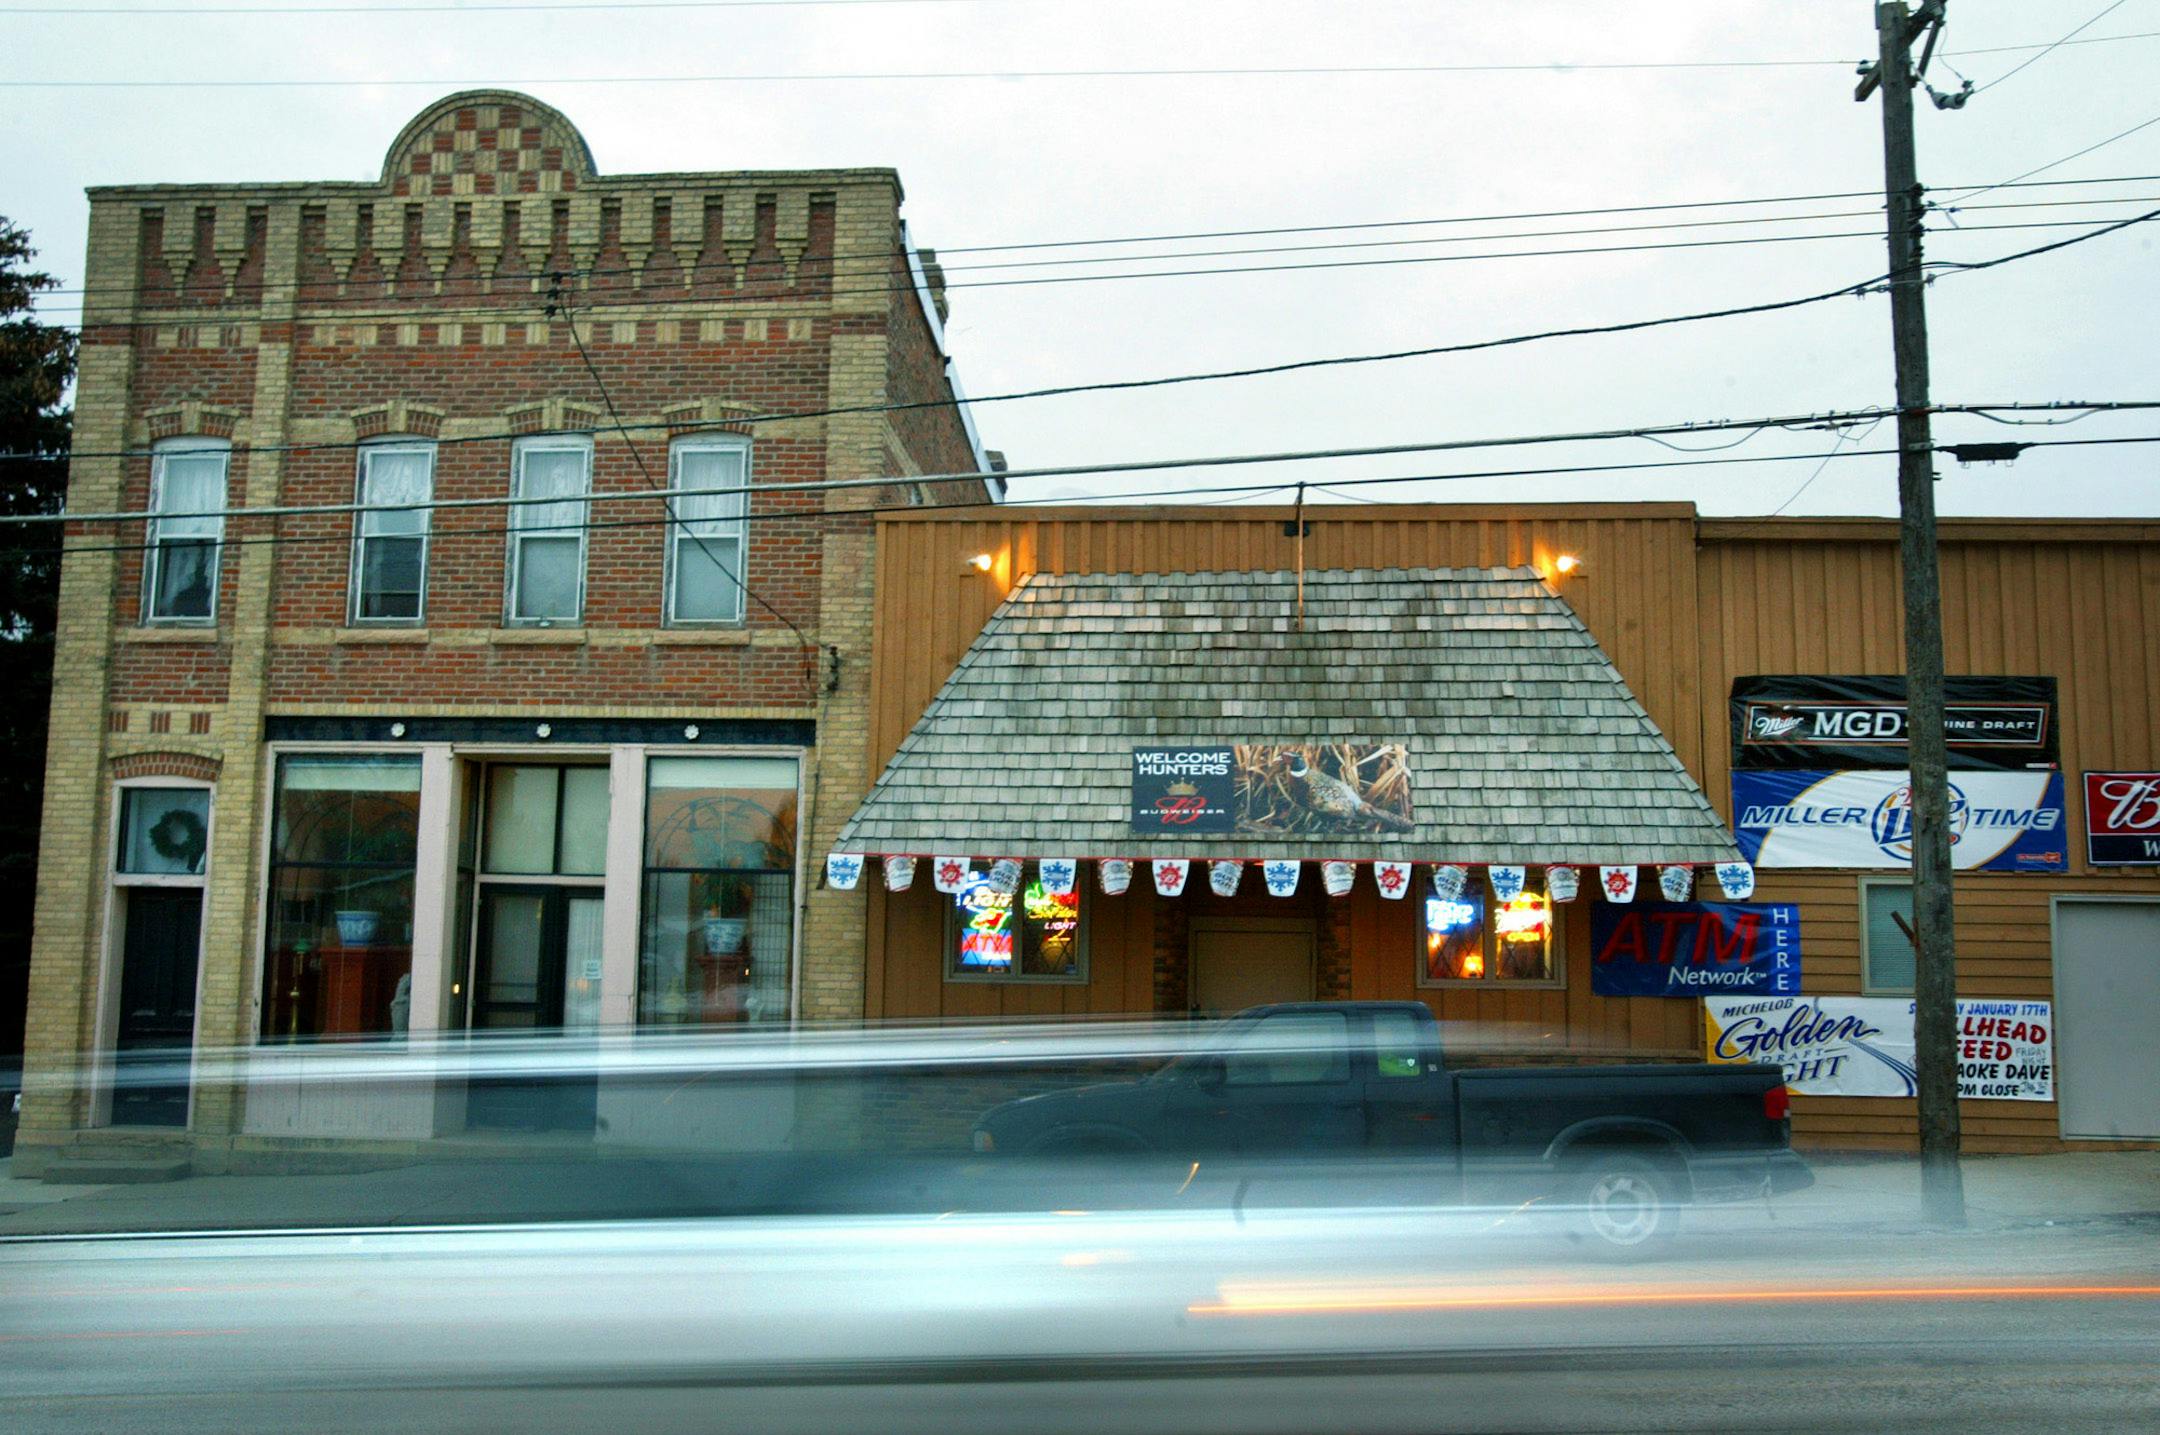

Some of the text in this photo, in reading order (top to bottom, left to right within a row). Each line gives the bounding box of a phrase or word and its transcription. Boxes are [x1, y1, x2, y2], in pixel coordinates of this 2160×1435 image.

[1755, 711, 1901, 736] Miller MGD
[1983, 720, 2036, 730] DRAFT
[1135, 752, 1231, 764] WELCOME
[1139, 763, 1229, 775] HUNTERS
[1741, 805, 1868, 829] MILLER
[1972, 807, 2060, 831] TIME
[1597, 911, 1761, 964] ATM
[1772, 908, 1790, 991] HERE
[1722, 999, 1795, 1018] MICHELOB
[1968, 1003, 2018, 1016] JANUARY
[2021, 1004, 2048, 1016] 17TH
[1715, 1004, 1881, 1059] Golden
[1760, 1048, 1824, 1063] DRAFT
[2005, 1063, 2050, 1080] DAVE
[1981, 1083, 2019, 1096] CLOSE
